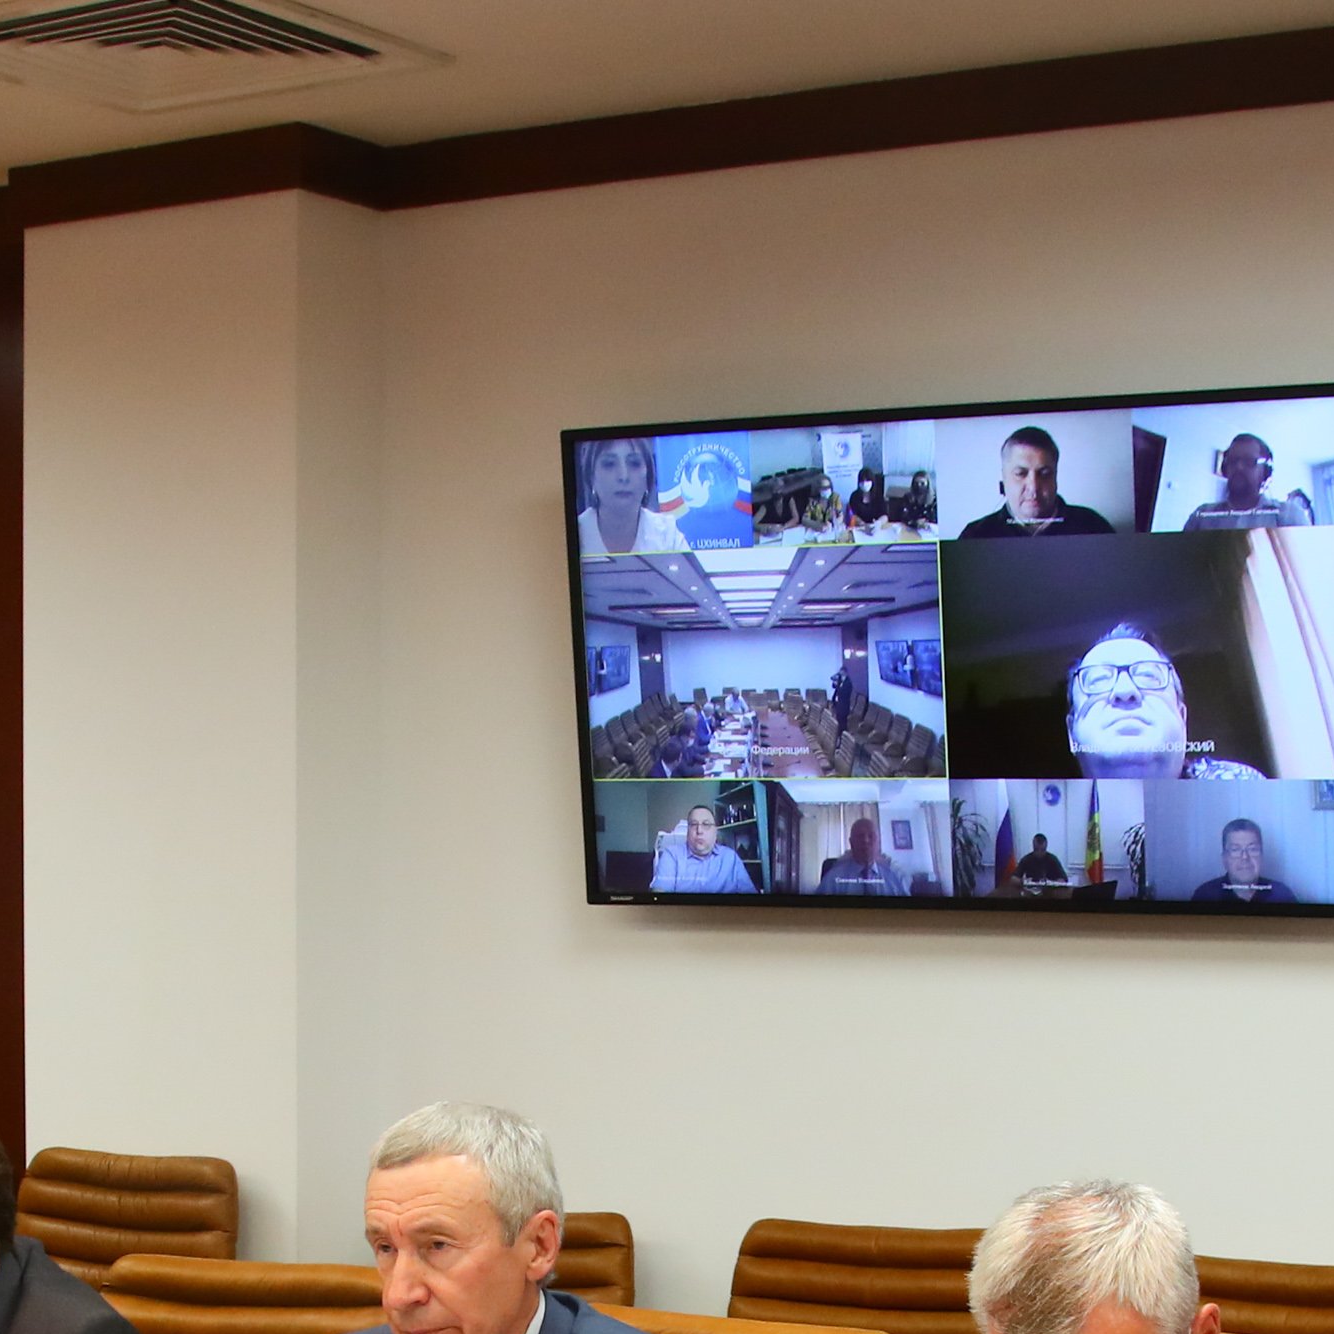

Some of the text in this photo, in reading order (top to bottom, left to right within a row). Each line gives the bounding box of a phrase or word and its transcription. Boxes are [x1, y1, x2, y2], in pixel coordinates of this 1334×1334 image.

[673, 442, 746, 483] РОССОТРУДНИЧЕСТВО
[697, 537, 741, 549] ЦХИНВАЛ
[751, 745, 810, 758] Федерации
